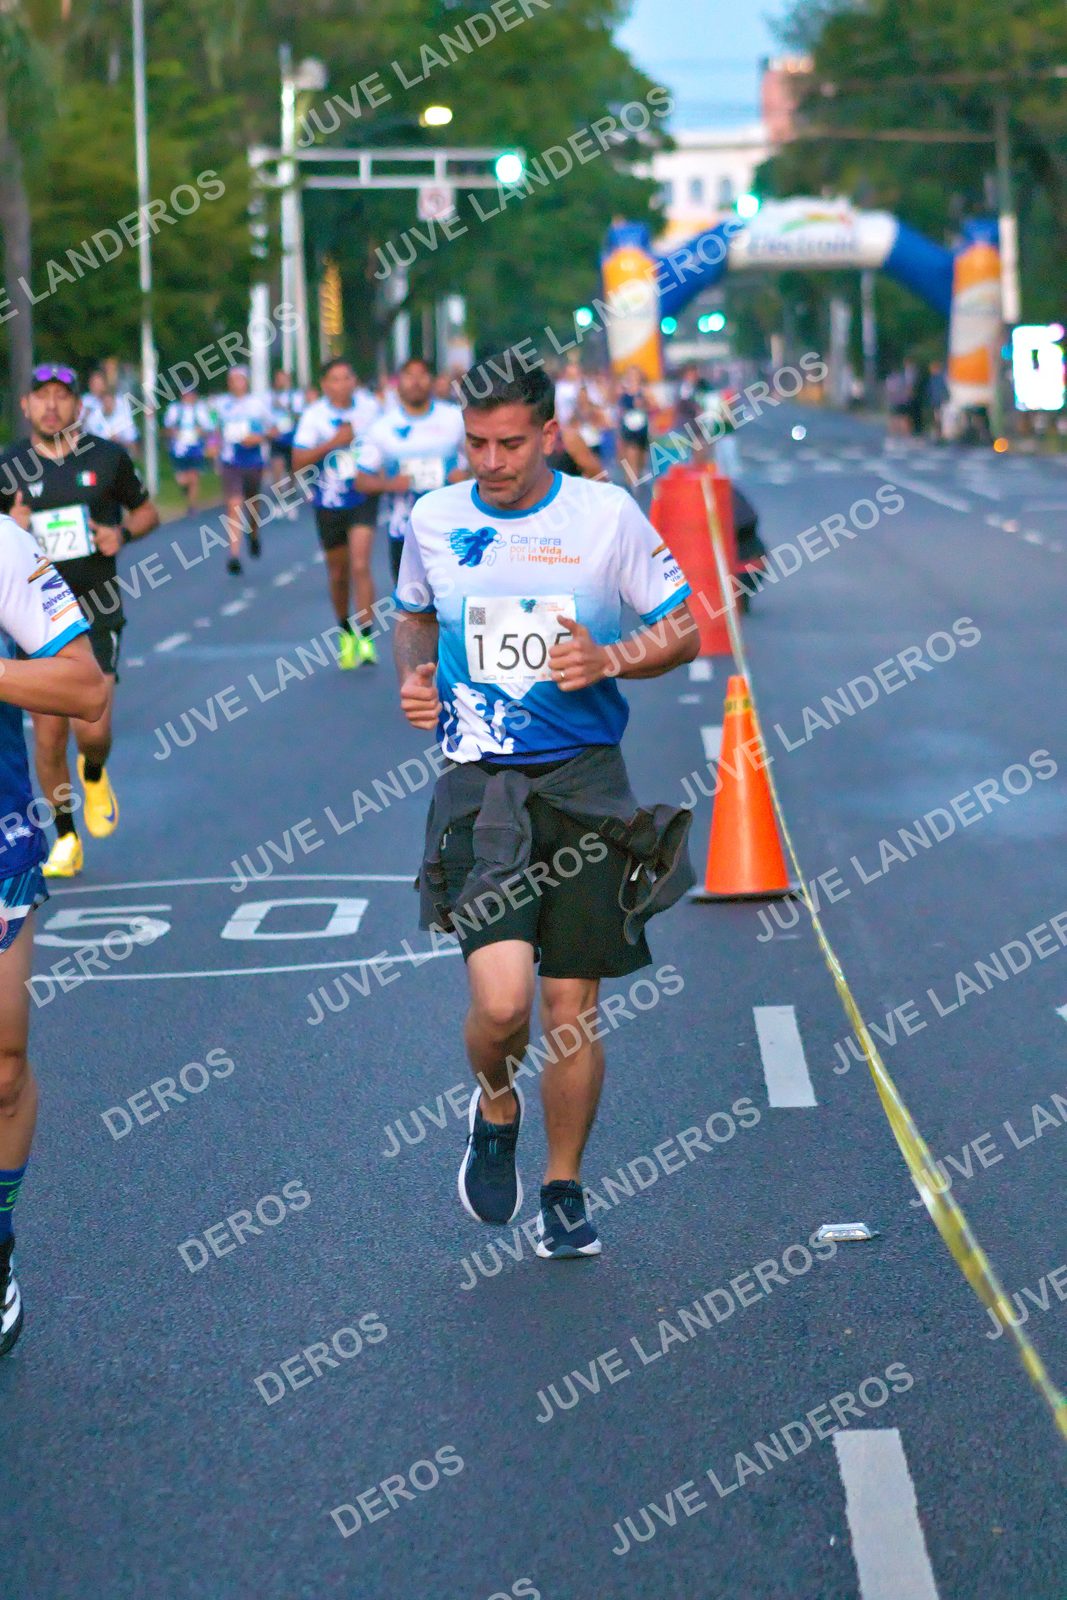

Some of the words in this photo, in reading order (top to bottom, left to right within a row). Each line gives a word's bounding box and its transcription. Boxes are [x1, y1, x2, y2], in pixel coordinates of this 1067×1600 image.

[510, 534, 561, 546] Carrera
[510, 546, 526, 554] por
[539, 546, 562, 555] Vida
[528, 554, 580, 565] Integridad
[33, 897, 370, 947] 50
